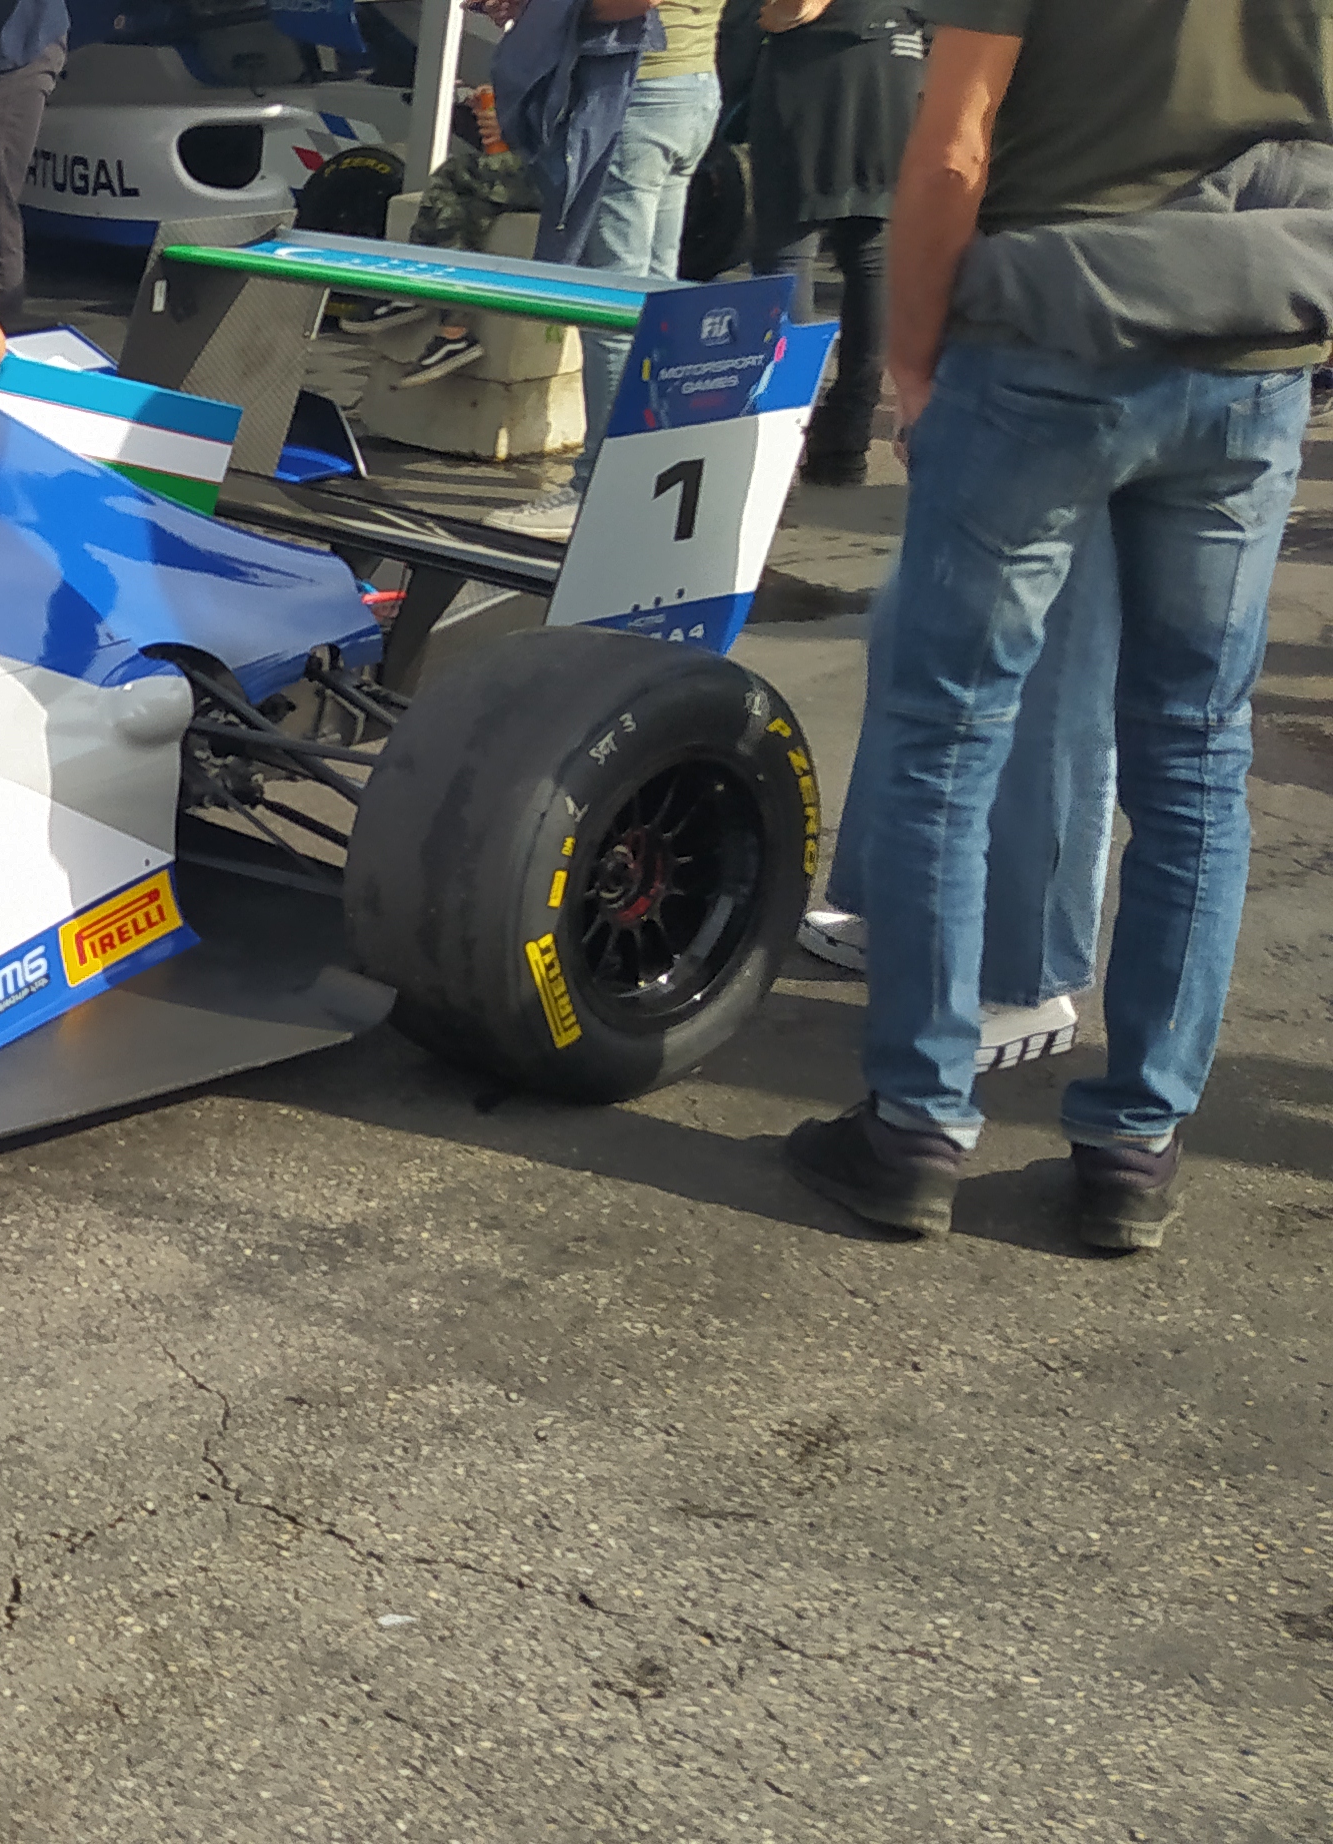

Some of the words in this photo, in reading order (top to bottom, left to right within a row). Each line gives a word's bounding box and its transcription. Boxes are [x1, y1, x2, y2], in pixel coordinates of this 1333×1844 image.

[26, 147, 140, 197] RTUGAL
[657, 354, 766, 381] MOTORSPORT
[680, 374, 740, 395] GAMES
[652, 457, 706, 542] 1
[787, 746, 821, 877] ZERO
[74, 887, 167, 967] PIRELLI
[524, 931, 583, 1050] PIRELLI
